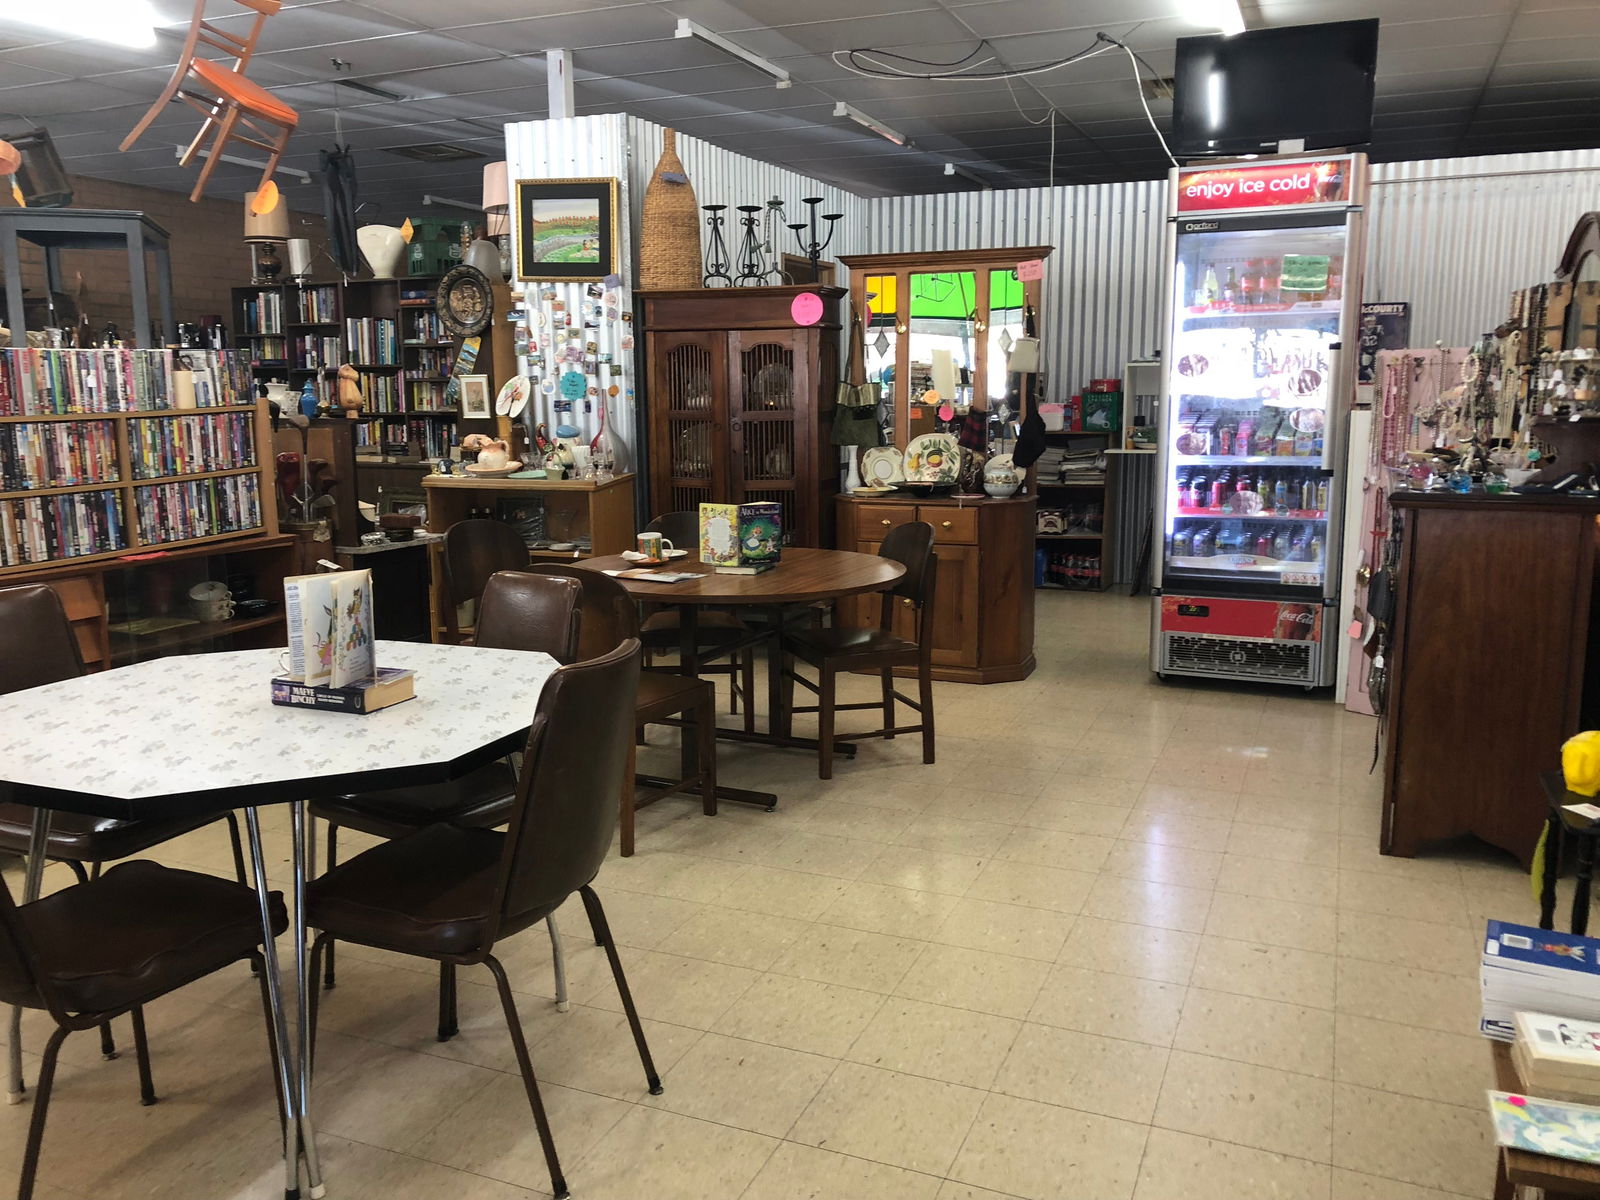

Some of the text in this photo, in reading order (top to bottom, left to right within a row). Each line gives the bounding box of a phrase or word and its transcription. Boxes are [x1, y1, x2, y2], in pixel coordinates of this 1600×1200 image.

[1186, 181, 1235, 199] enjoy
[1239, 178, 1265, 193] ice
[1269, 173, 1311, 192] cold
[292, 686, 315, 697] MAEVE
[290, 694, 316, 705] BINCHY
